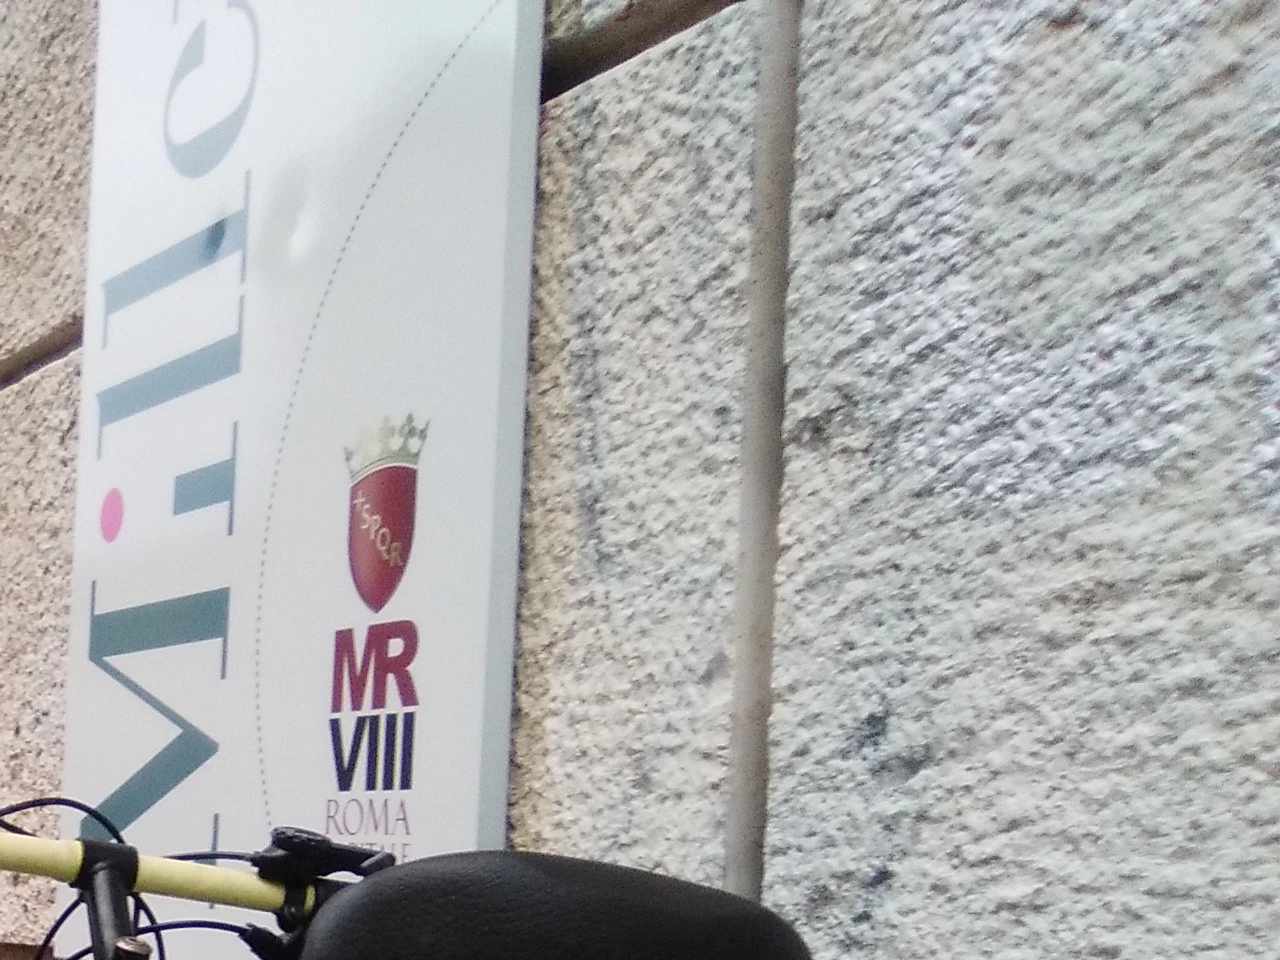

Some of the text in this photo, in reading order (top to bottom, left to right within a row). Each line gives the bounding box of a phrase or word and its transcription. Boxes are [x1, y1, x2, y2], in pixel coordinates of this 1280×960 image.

[331, 619, 419, 713] MR
[329, 711, 416, 792] VIII
[326, 798, 410, 836] ROMA
